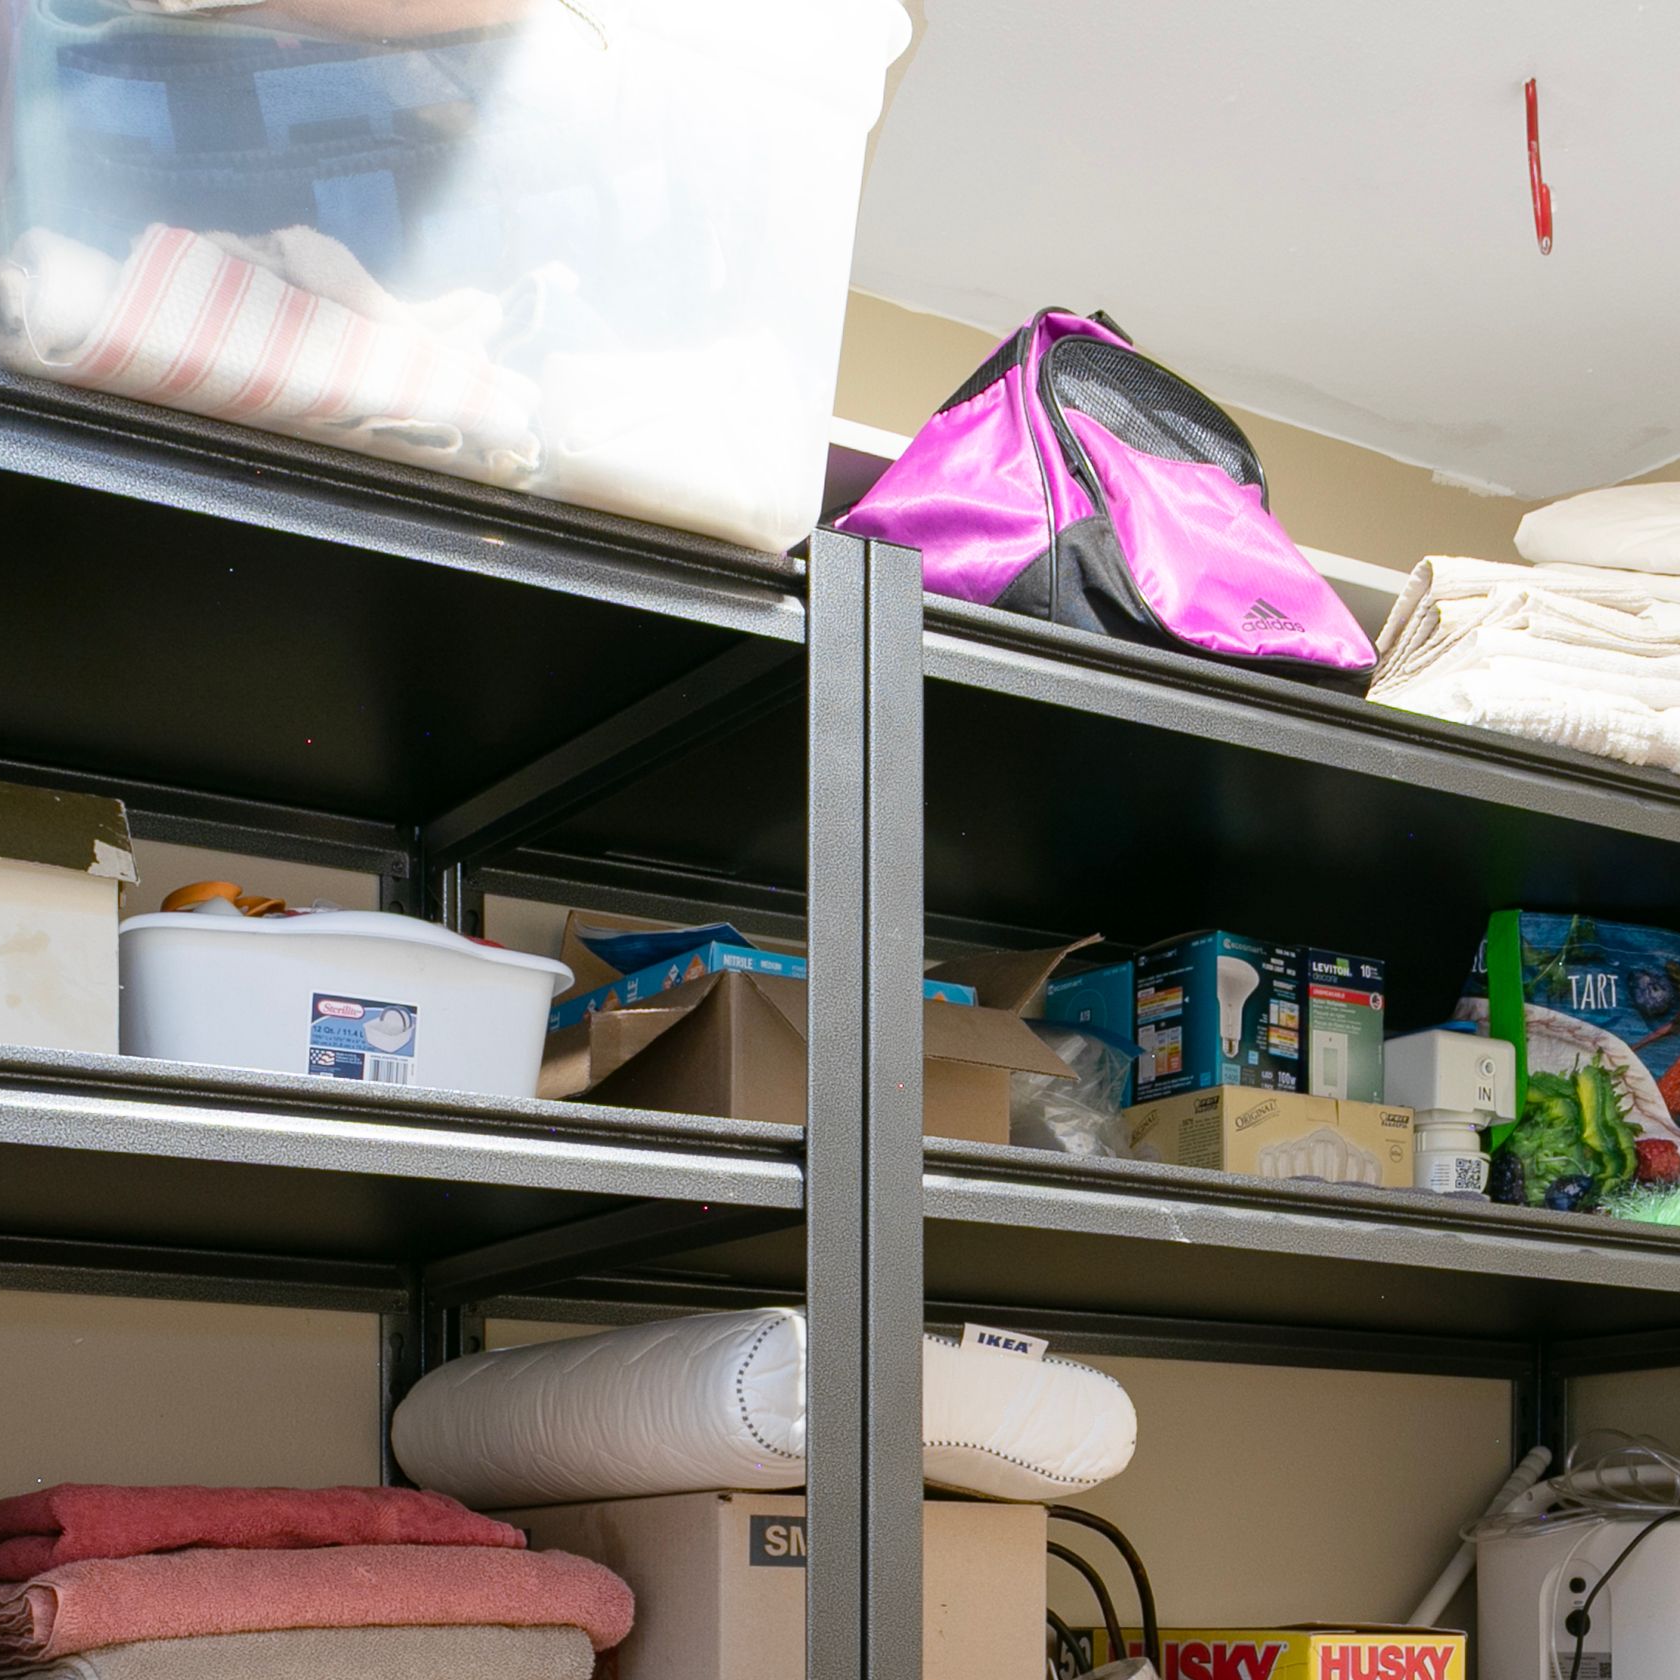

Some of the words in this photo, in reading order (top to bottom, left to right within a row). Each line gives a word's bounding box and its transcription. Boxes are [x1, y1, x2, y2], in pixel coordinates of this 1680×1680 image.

[1242, 619, 1305, 632] adidas
[723, 954, 753, 969] NITRILE
[1312, 962, 1351, 977] LEVITON
[1360, 965, 1371, 978] 10
[1567, 974, 1619, 1010] TART
[1477, 1086, 1492, 1103] IN
[977, 1332, 1028, 1354] IKEA
